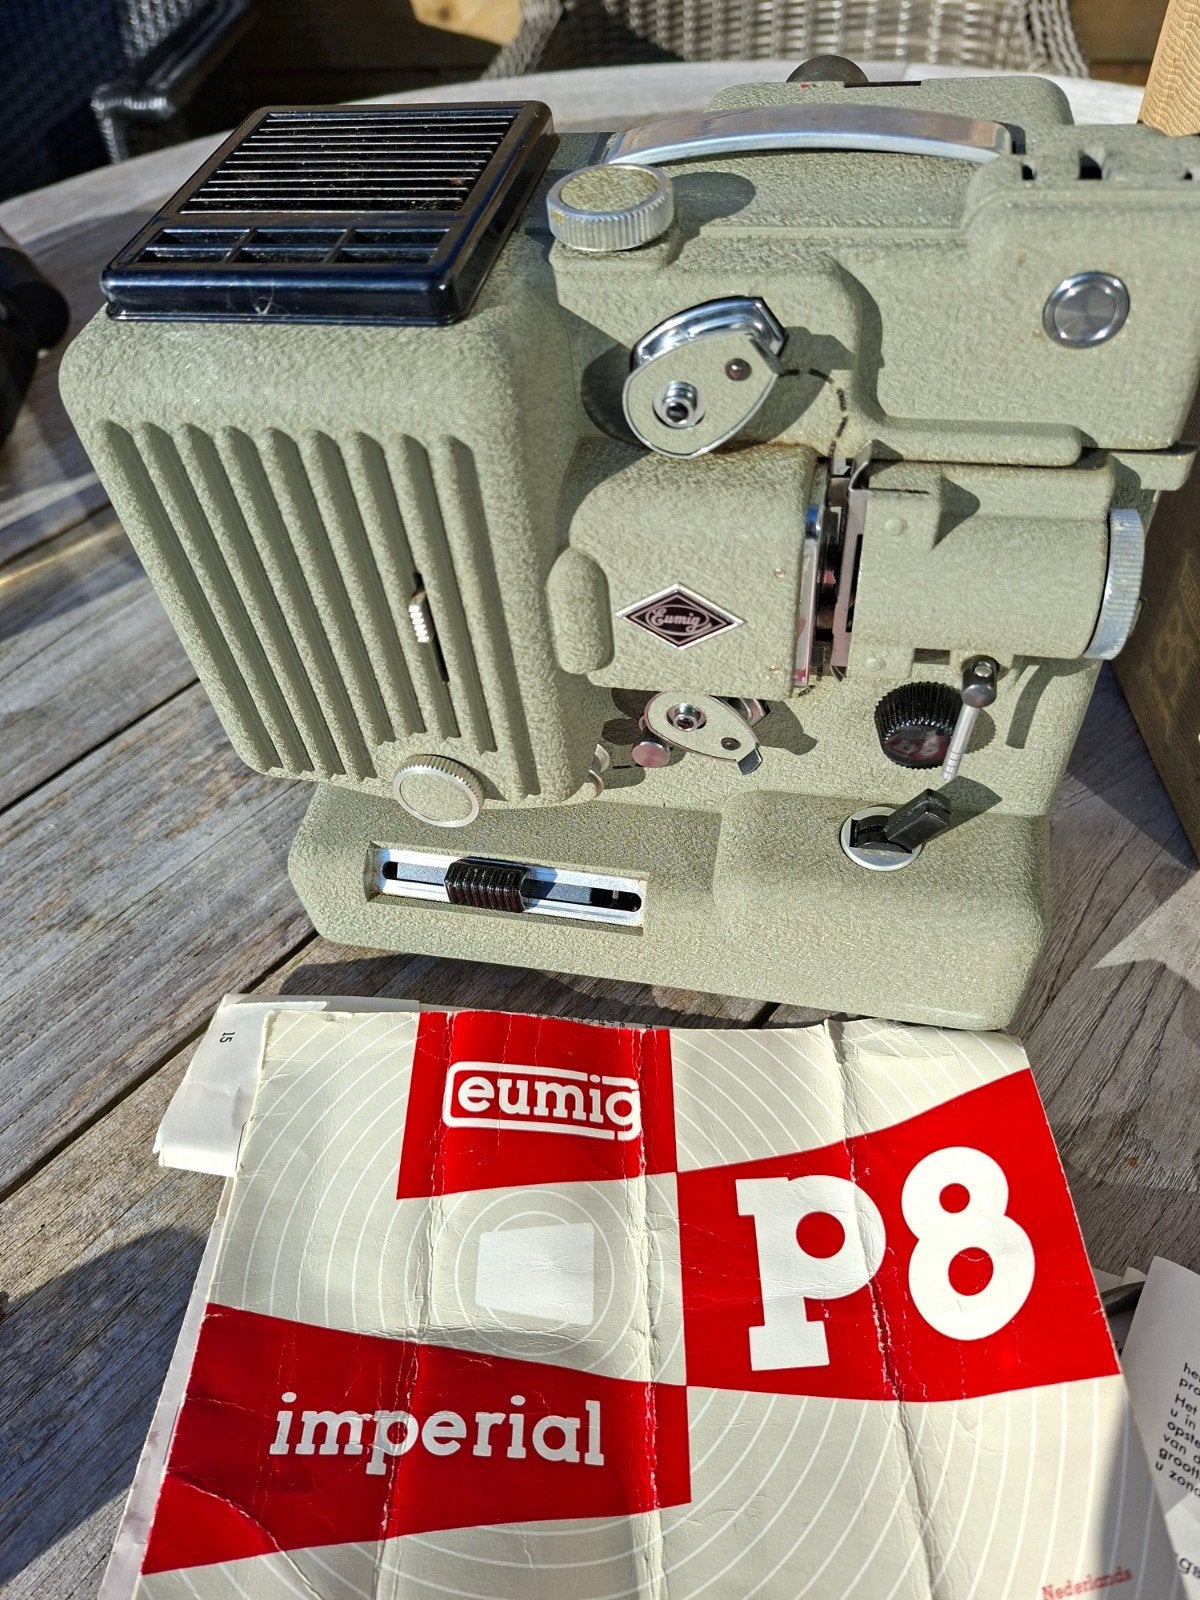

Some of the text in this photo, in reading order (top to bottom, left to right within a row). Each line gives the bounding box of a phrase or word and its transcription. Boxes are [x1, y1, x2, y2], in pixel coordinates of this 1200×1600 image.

[650, 607, 702, 633] Eumig
[219, 1031, 236, 1043] 15
[458, 1074, 641, 1141] eumig
[735, 1146, 1035, 1371] P8
[1183, 1362, 1200, 1382] he
[1174, 1393, 1198, 1416] Het
[1170, 1408, 1196, 1430] u in
[269, 1391, 605, 1475] imperial
[1163, 1434, 1187, 1455] van
[1155, 1461, 1164, 1472] u
[1159, 1448, 1200, 1482] groott
[1041, 1565, 1134, 1600] Nederlands
